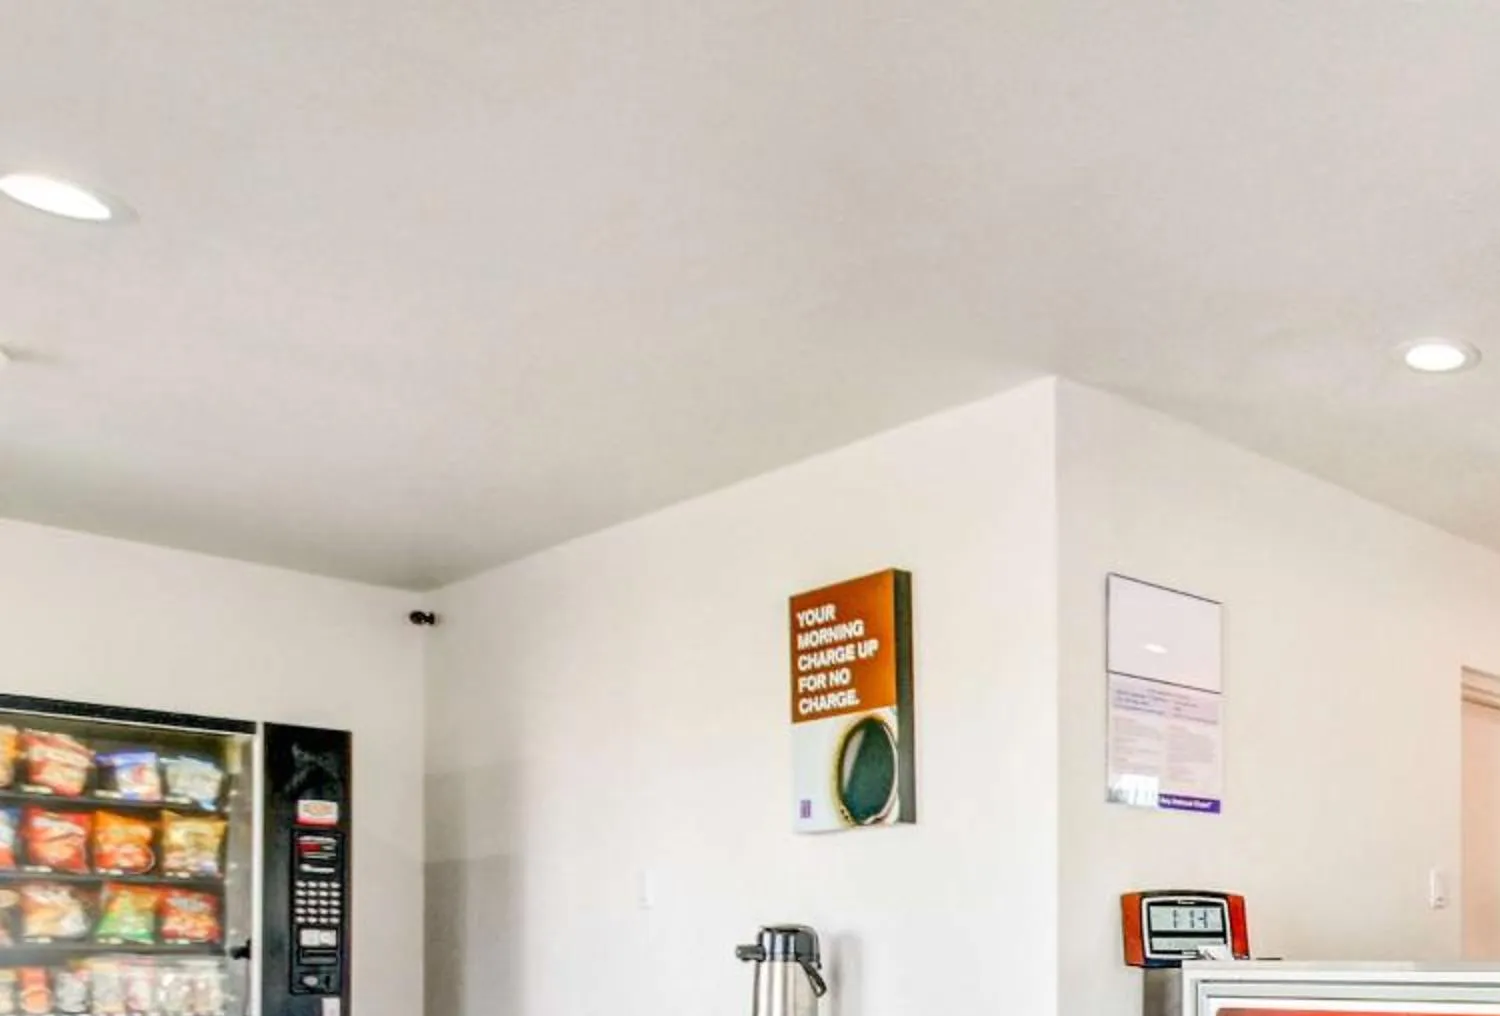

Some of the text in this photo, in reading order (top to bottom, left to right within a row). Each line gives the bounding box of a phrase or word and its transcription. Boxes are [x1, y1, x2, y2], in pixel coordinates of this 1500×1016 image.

[796, 603, 836, 628] YOUR
[797, 619, 864, 650] MORNING
[798, 638, 879, 671] CHARGE UP
[798, 667, 851, 693] FOR NO
[799, 688, 860, 714] CHARGE.
